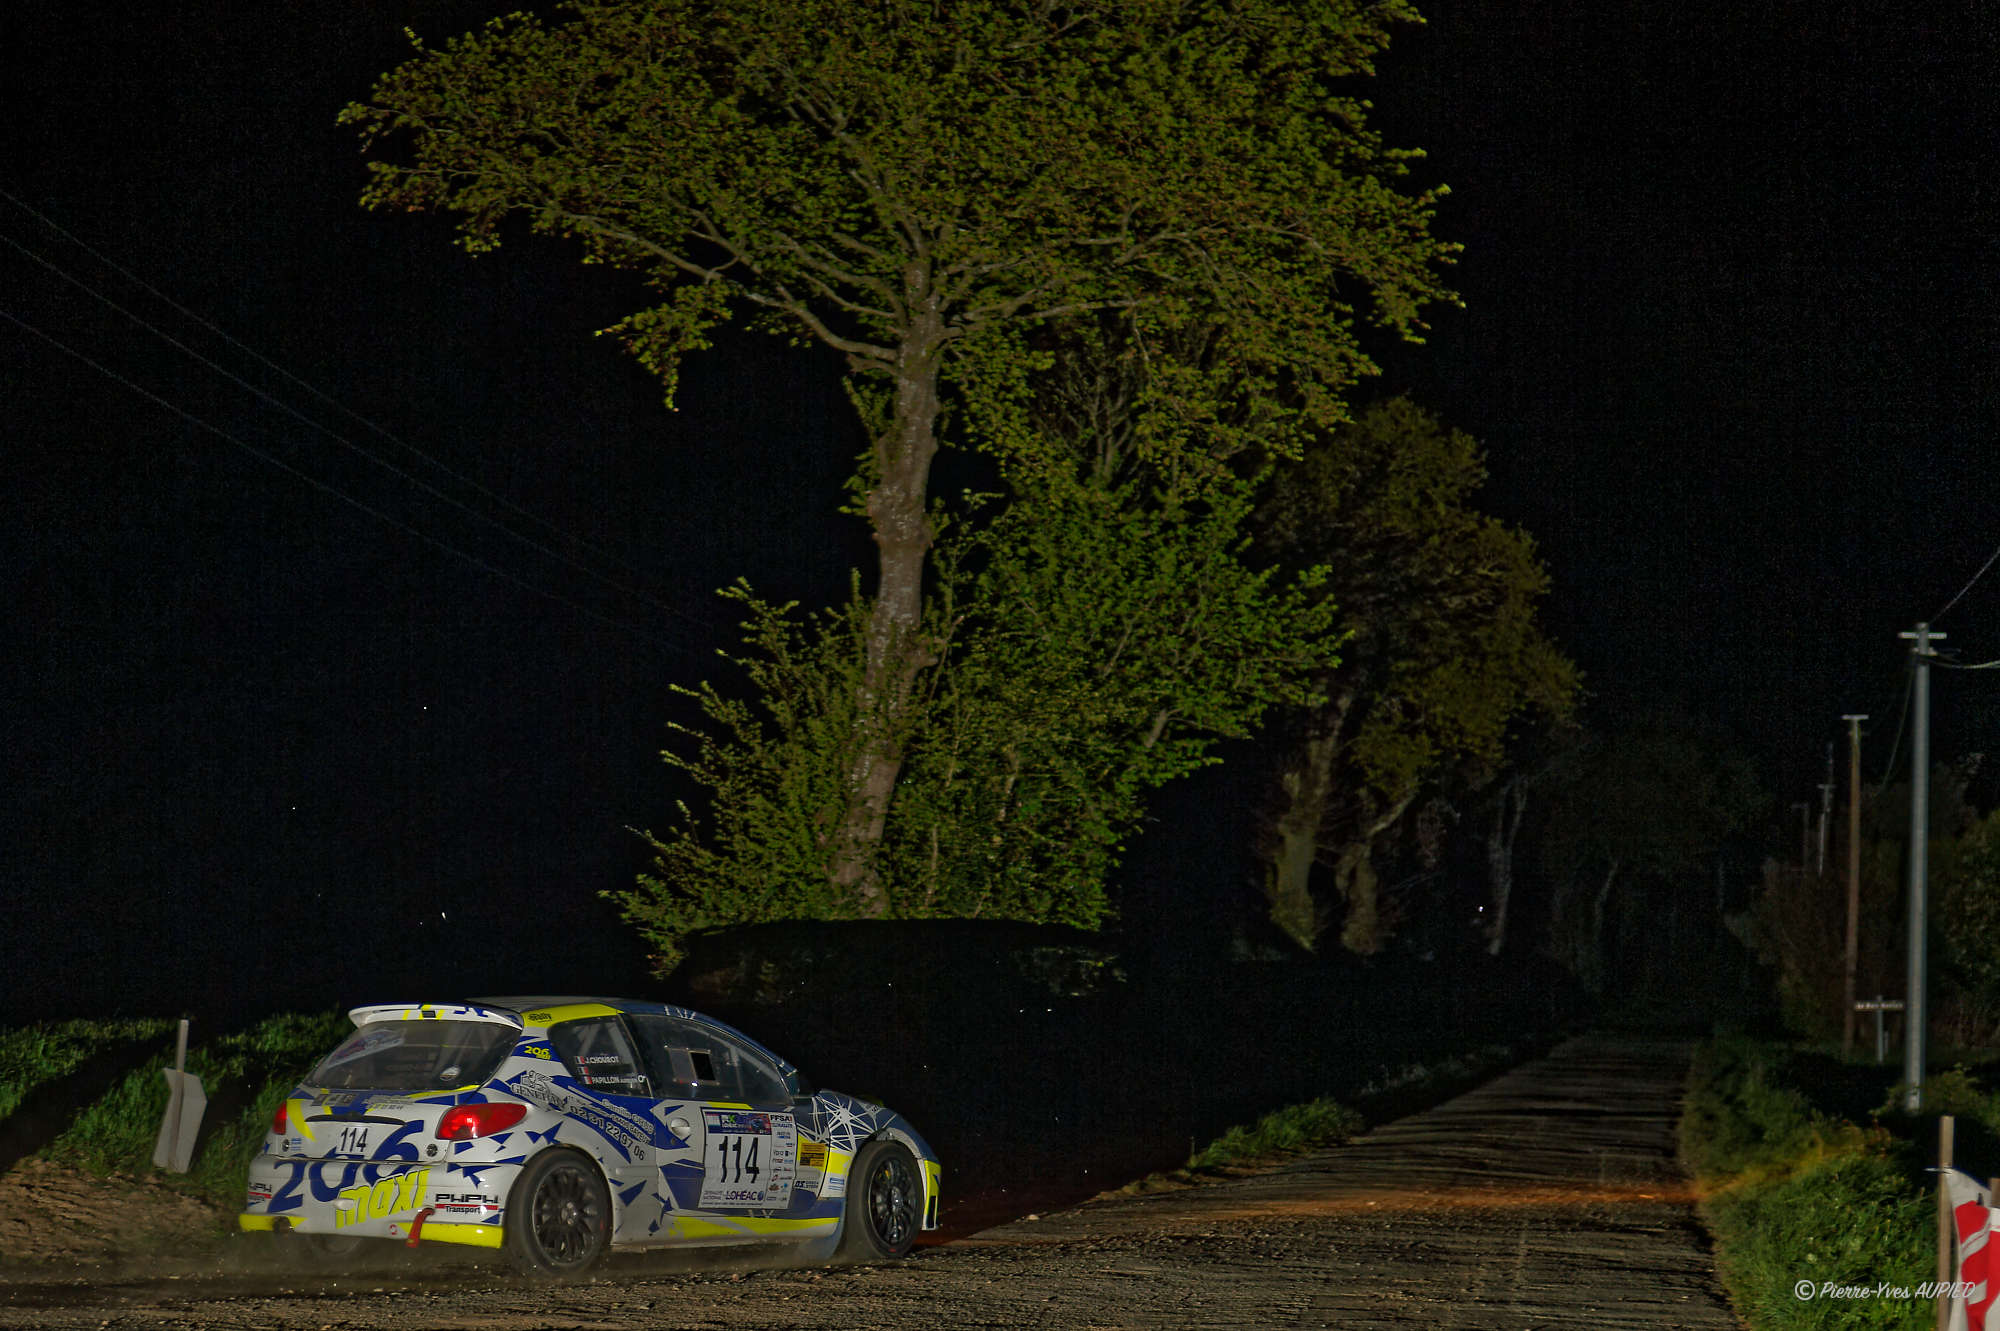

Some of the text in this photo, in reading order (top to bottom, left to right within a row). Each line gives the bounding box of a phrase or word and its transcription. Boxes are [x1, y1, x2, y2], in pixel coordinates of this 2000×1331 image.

[523, 1046, 550, 1057] 206
[340, 1127, 368, 1152] 114
[606, 1122, 620, 1139] 22
[621, 1133, 634, 1148] 97
[633, 1145, 645, 1160] 06
[267, 1120, 425, 1213] 206
[719, 1135, 760, 1184] 114
